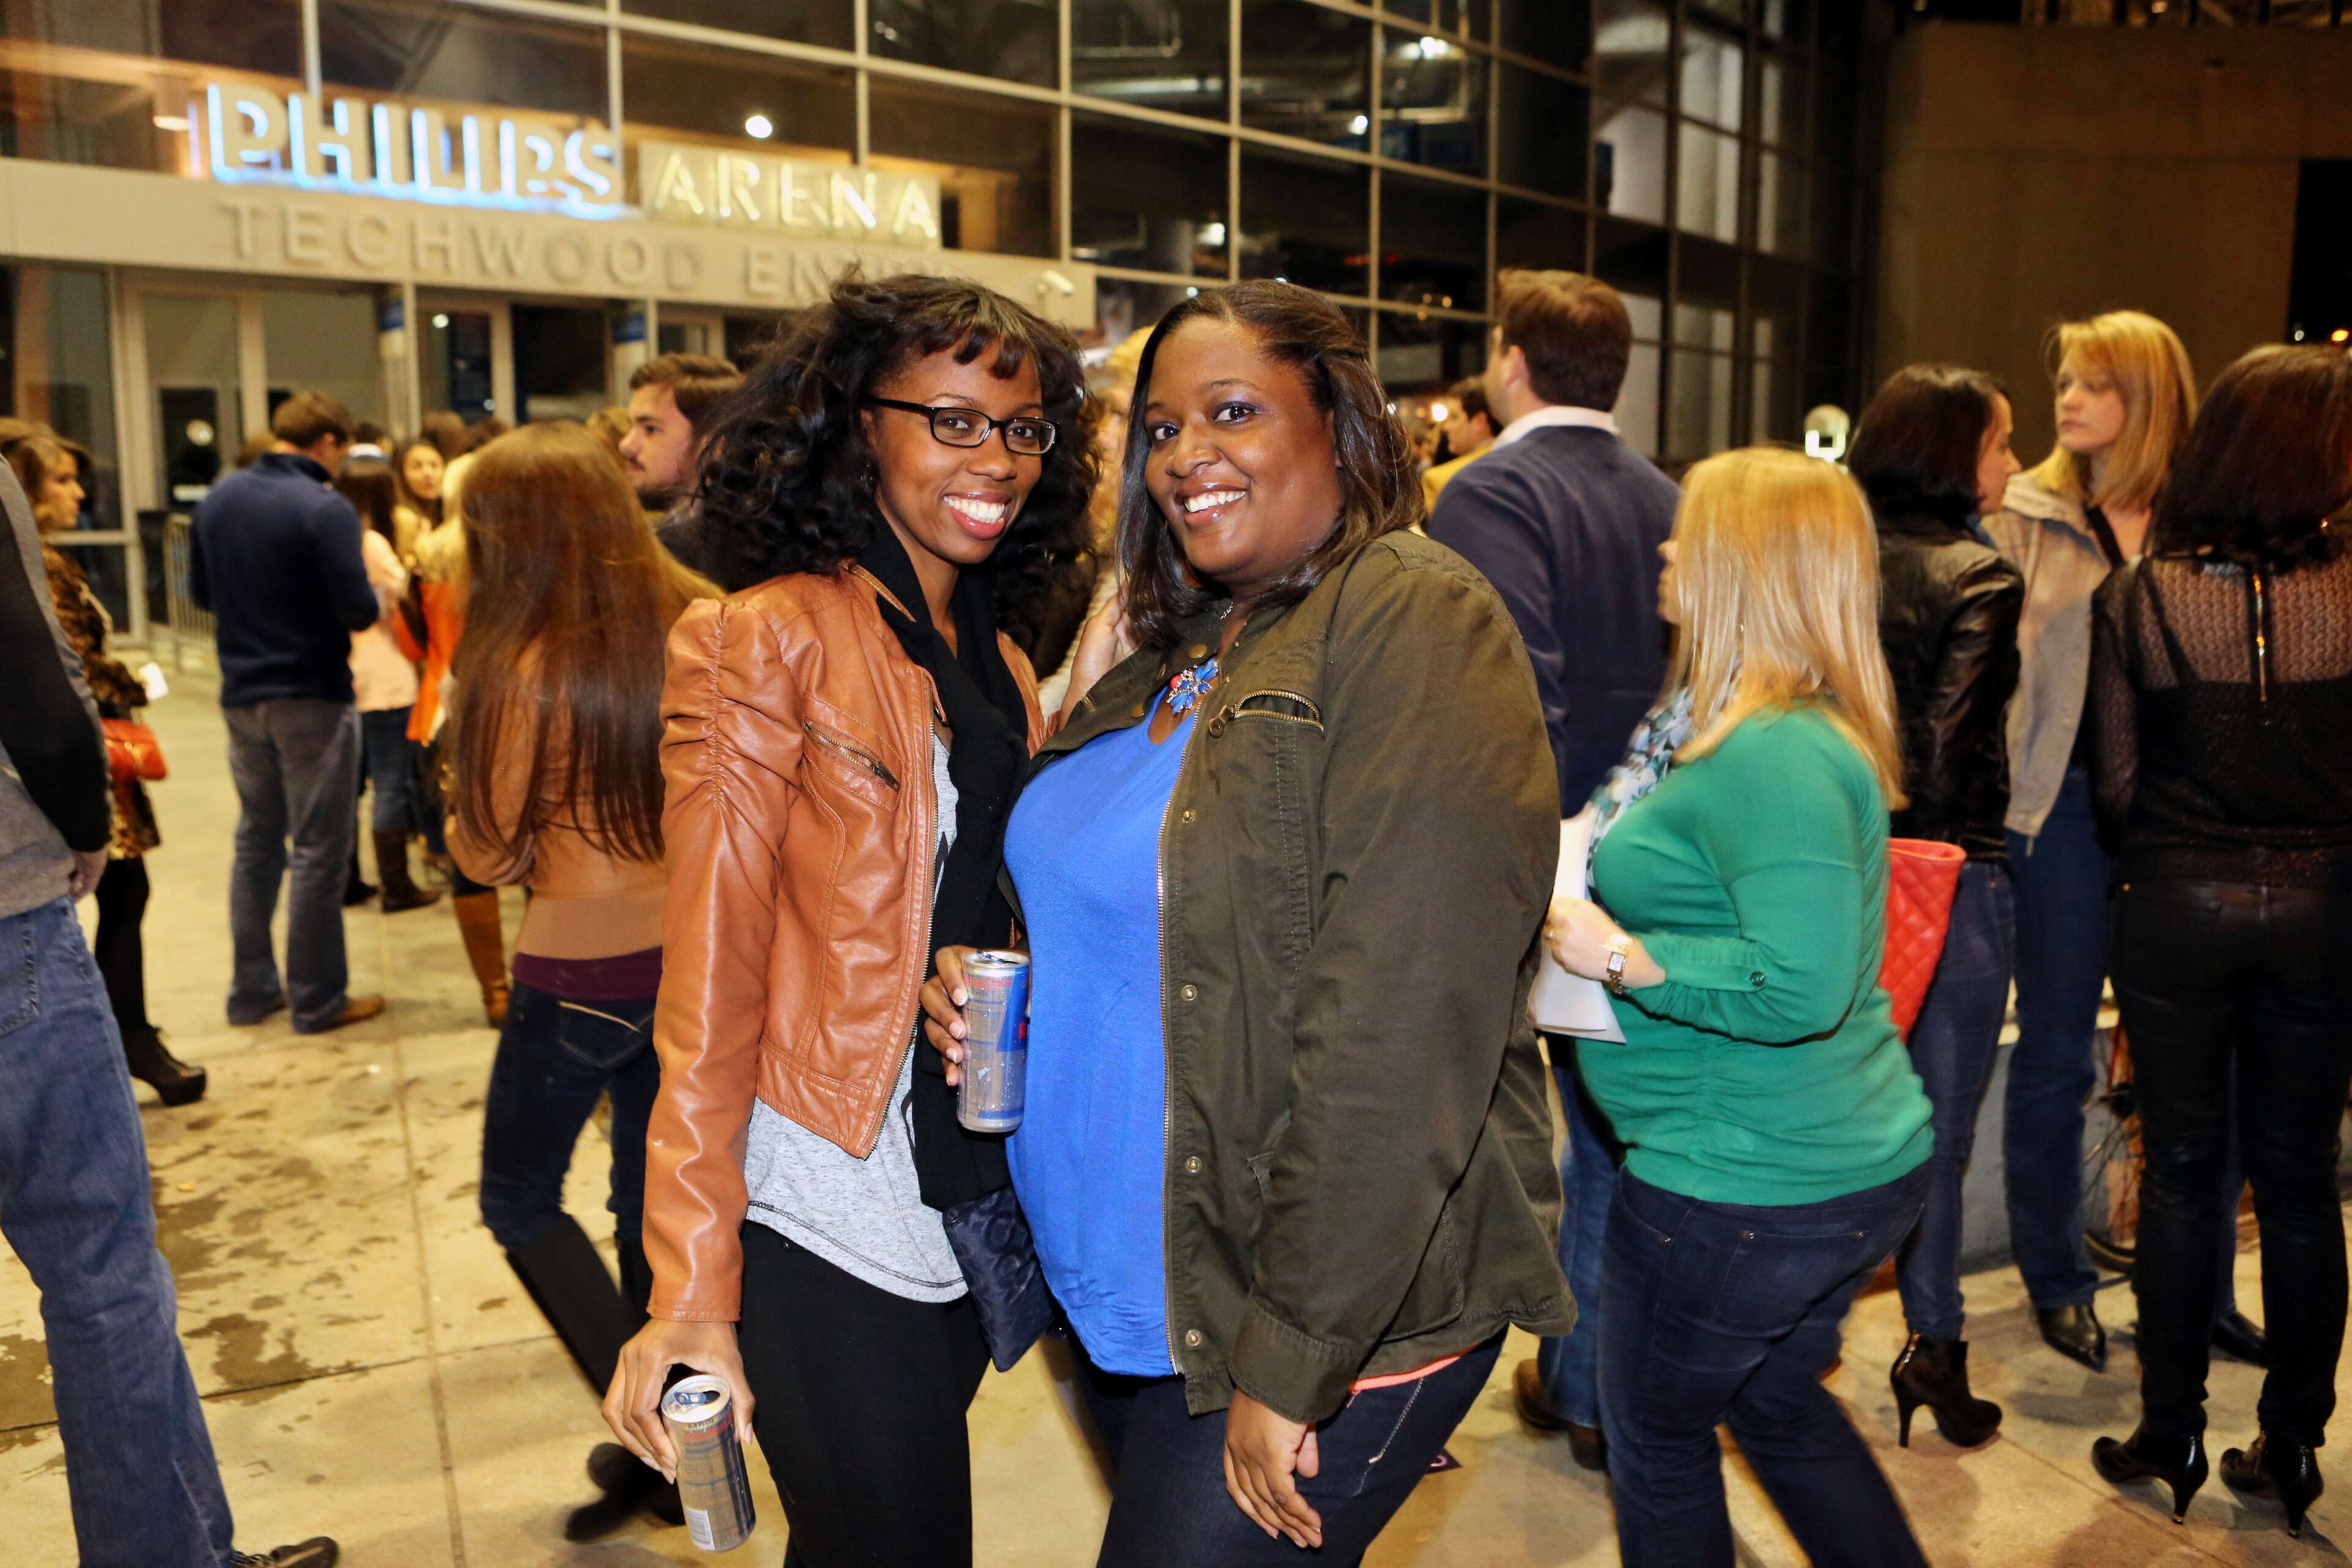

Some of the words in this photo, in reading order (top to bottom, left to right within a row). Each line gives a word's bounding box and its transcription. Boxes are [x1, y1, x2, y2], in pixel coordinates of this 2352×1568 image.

[206, 83, 624, 218] PHILIPS
[655, 151, 939, 238] ARENA
[219, 200, 701, 292] TECHWOOD
